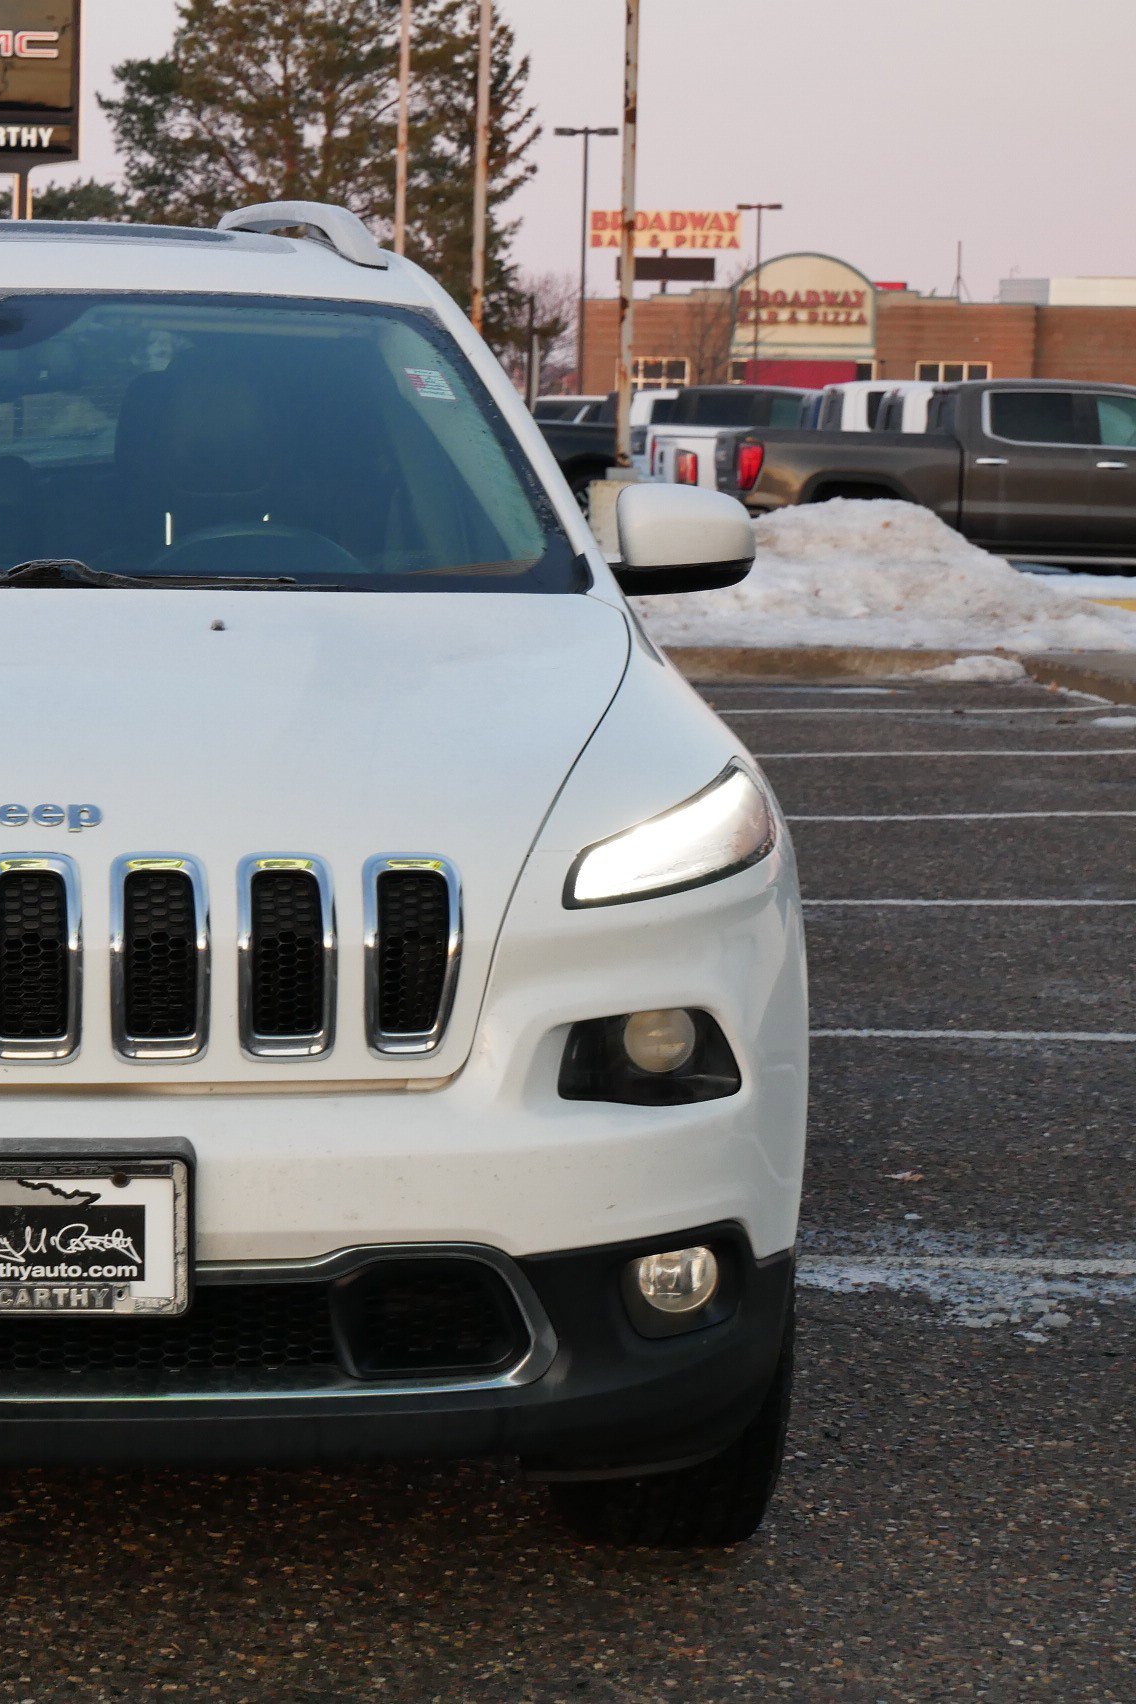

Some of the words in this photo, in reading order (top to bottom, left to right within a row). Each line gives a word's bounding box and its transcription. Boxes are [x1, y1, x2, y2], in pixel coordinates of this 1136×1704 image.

[649, 234, 661, 248] &
[675, 235, 740, 248] PIZZA
[738, 290, 865, 308] BROADWAY
[807, 311, 867, 325] PIZZA
